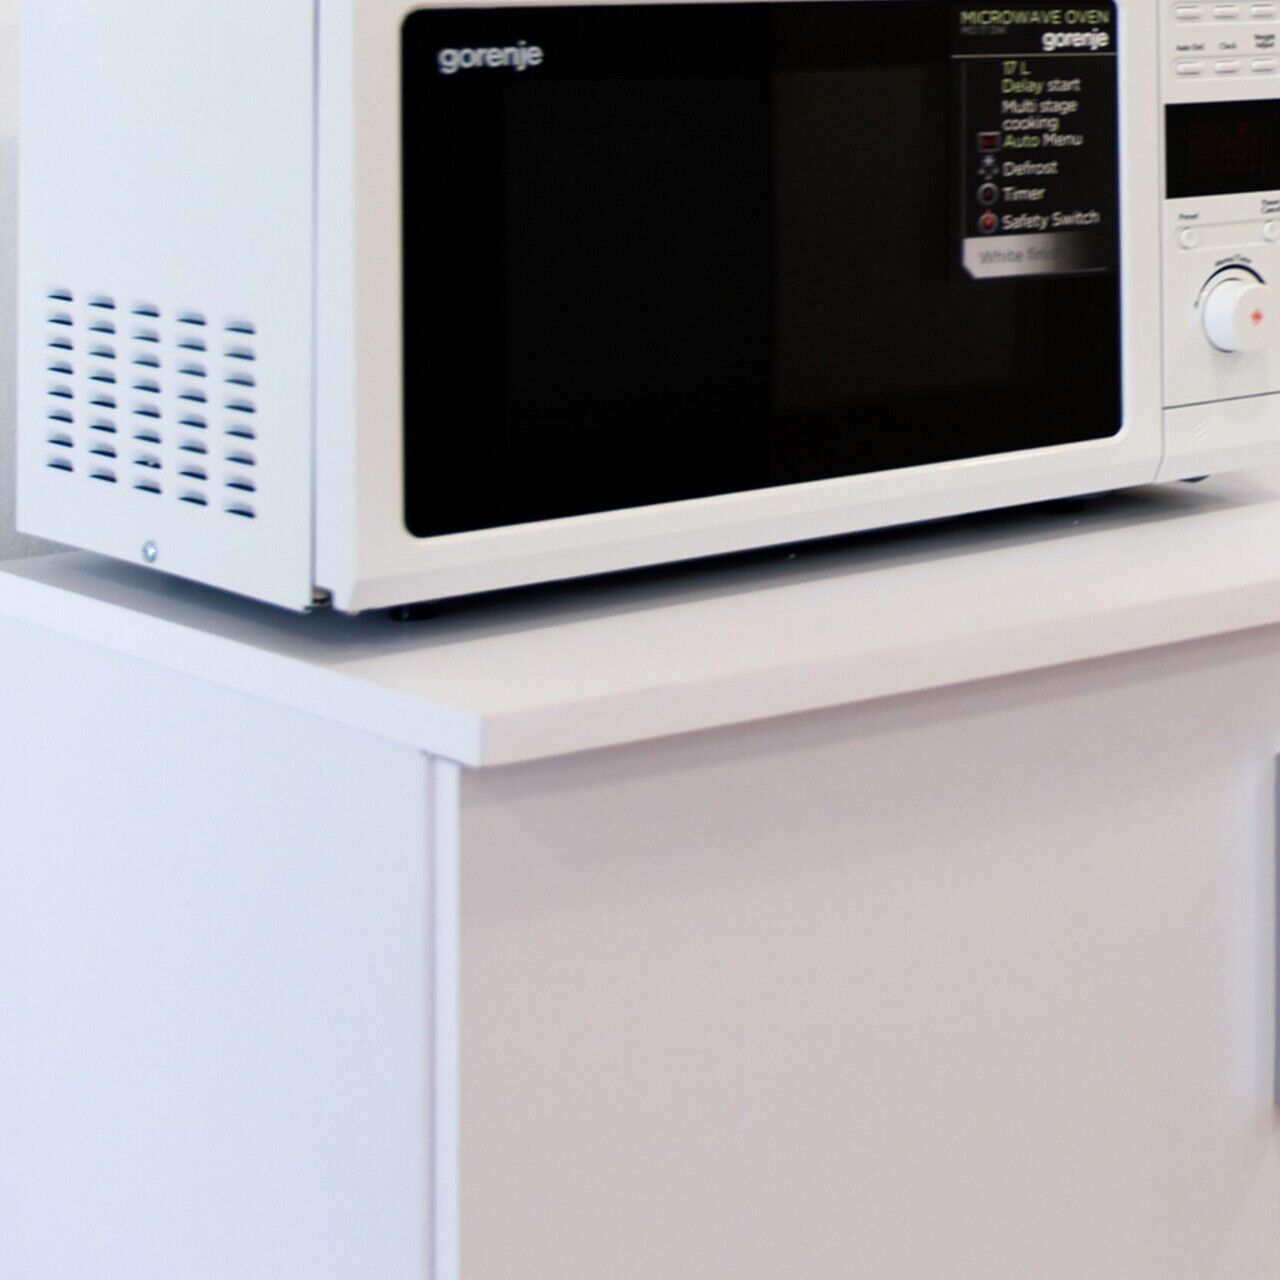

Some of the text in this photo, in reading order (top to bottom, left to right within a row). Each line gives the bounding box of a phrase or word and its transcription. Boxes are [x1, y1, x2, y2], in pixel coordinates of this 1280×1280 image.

[960, 8, 1111, 25] MICROWAVE OVEN
[1042, 28, 1110, 51] gorenje
[438, 40, 544, 74] gorenje
[1002, 60, 1031, 75] 17 L
[1001, 78, 1081, 95] Delay start
[1001, 100, 1079, 115] Multi stage
[1001, 116, 1060, 132] cooking
[1003, 133, 1084, 148] Auto Menu
[1002, 160, 1059, 177] Defrost
[1002, 186, 1047, 202] Timer
[1001, 210, 1101, 230] Safety Switch
[978, 249, 1024, 265] White
